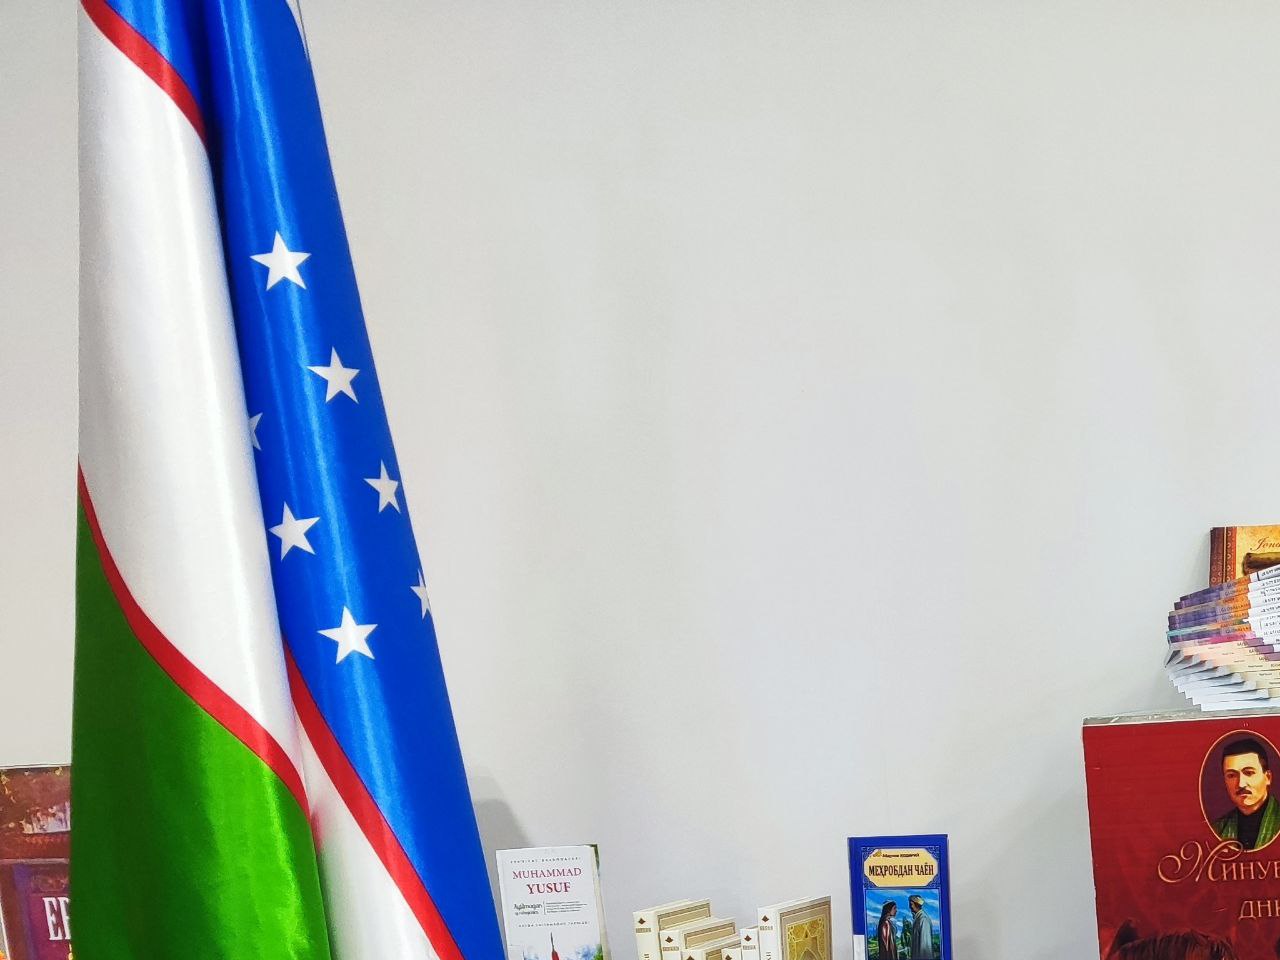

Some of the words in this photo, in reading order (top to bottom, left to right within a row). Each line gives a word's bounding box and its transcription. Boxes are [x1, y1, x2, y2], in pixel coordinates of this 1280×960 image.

[513, 868, 582, 879] MUHAMMAD
[915, 862, 934, 875] ЧАЁН
[526, 882, 570, 894] YUSUF
